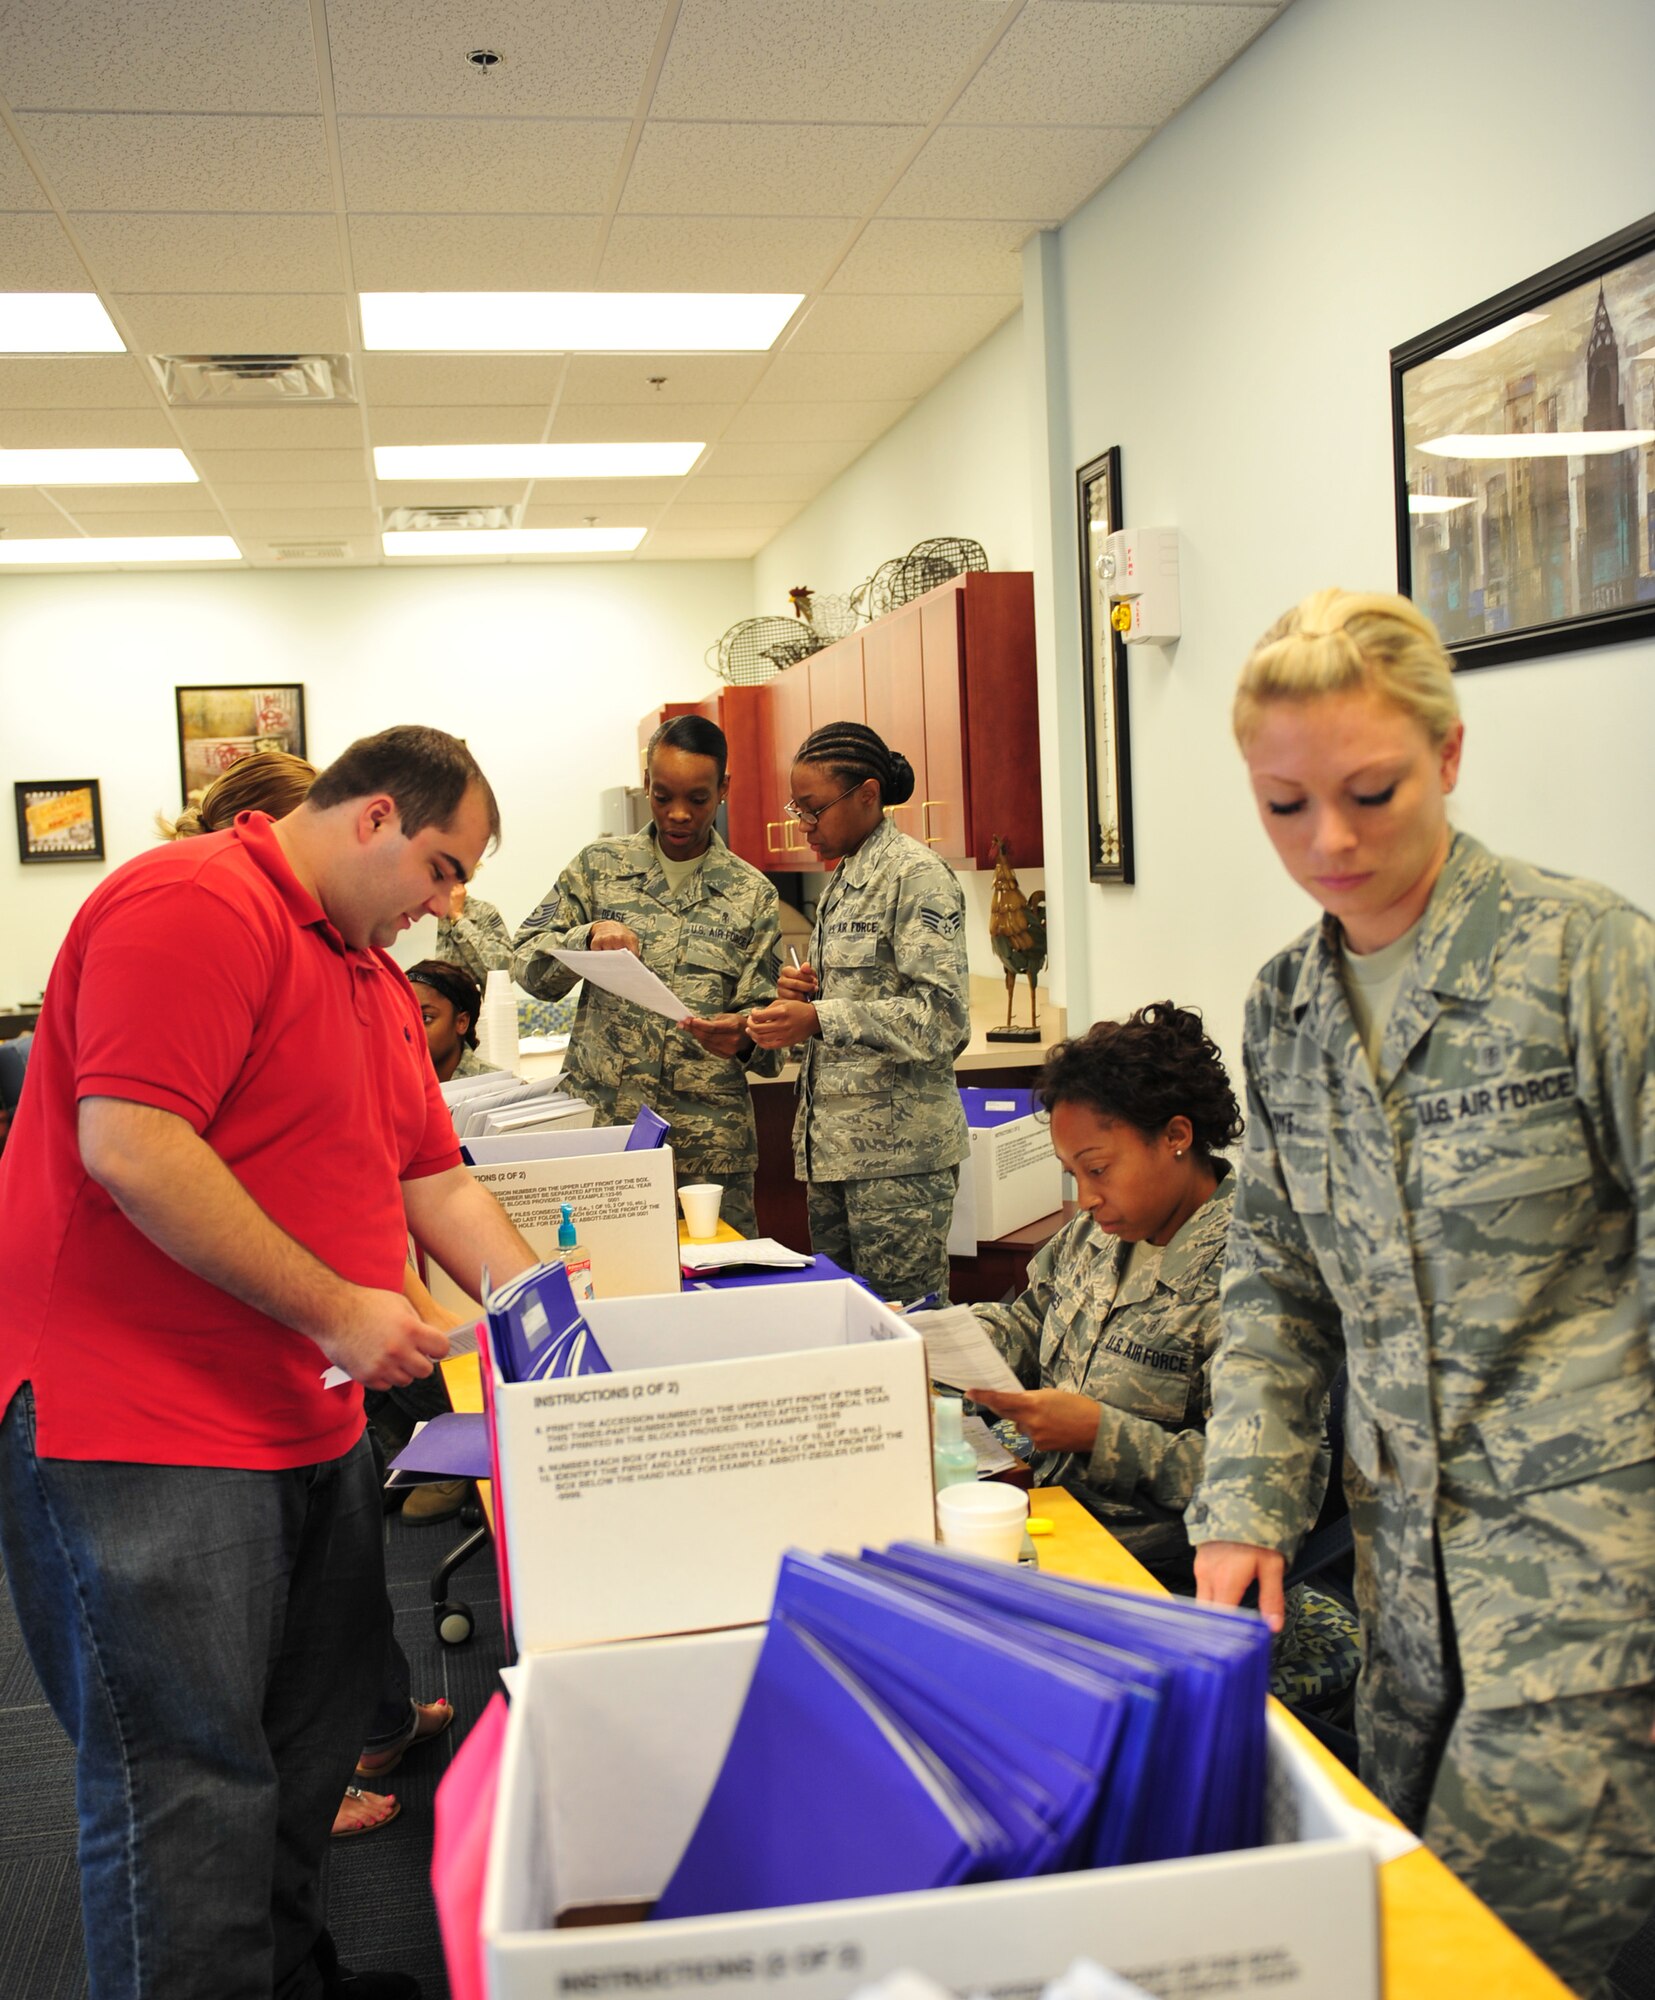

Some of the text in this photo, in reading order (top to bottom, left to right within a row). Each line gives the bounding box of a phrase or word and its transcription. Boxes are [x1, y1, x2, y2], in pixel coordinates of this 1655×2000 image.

[691, 924, 748, 948] U.S. AIR FORCE
[851, 921, 878, 933] FORCE
[1418, 1072, 1576, 1126] U.S. AIR FORCE
[473, 1171, 526, 1182] TIONS (2 OF 2)
[513, 1187, 537, 1195] NUMBER
[560, 1183, 579, 1191] UPPER
[507, 1199, 530, 1207] BLOCKS
[551, 1188, 583, 1197] SEPARATED
[585, 1186, 603, 1194] AFTER
[1105, 1334, 1189, 1373] U.S. AIR FORCE
[534, 1381, 680, 1408] INSTRUCTIONS (2 OF 2)
[599, 1415, 654, 1426] ACCESSION
[657, 1409, 697, 1420] NUMBER
[737, 1401, 768, 1411] UPPER
[770, 1397, 793, 1407] LEFT
[796, 1393, 826, 1403] FRONT
[829, 1391, 841, 1399] OF
[844, 1389, 861, 1397] THE
[633, 1422, 674, 1432] NUMBER
[706, 1416, 718, 1424] BE
[721, 1410, 776, 1421] SEPARATED
[779, 1406, 808, 1415] AFTER
[811, 1403, 827, 1411] THE
[866, 1394, 890, 1404] YEAR
[627, 1435, 644, 1443] THE
[647, 1430, 687, 1440] BLOCKS
[744, 1421, 764, 1429] FOR
[548, 1461, 590, 1471] NUMBER
[593, 1457, 620, 1466] EACH
[623, 1455, 642, 1463] BOX
[645, 1452, 657, 1460] OF
[660, 1448, 687, 1458] FILES
[689, 1438, 766, 1454] CONSECUTIVELY
[796, 1433, 809, 1441] OF
[833, 1429, 845, 1437] OF
[555, 1470, 597, 1480] IDENTIFY
[600, 1466, 618, 1474] THE
[622, 1463, 648, 1472] FIRST
[652, 1460, 671, 1469] AND
[674, 1456, 697, 1466] LAST
[700, 1452, 738, 1463] FOLDER
[753, 1447, 778, 1457] EACH
[780, 1444, 799, 1453] BOX
[838, 1435, 868, 1445] FRONT
[871, 1433, 882, 1441] OF
[886, 1430, 903, 1439] THE
[578, 1478, 613, 1488] BELOW
[617, 1475, 634, 1483] THE
[637, 1471, 664, 1480] HAND
[697, 1465, 717, 1473] FOR
[849, 1446, 863, 1454] OR
